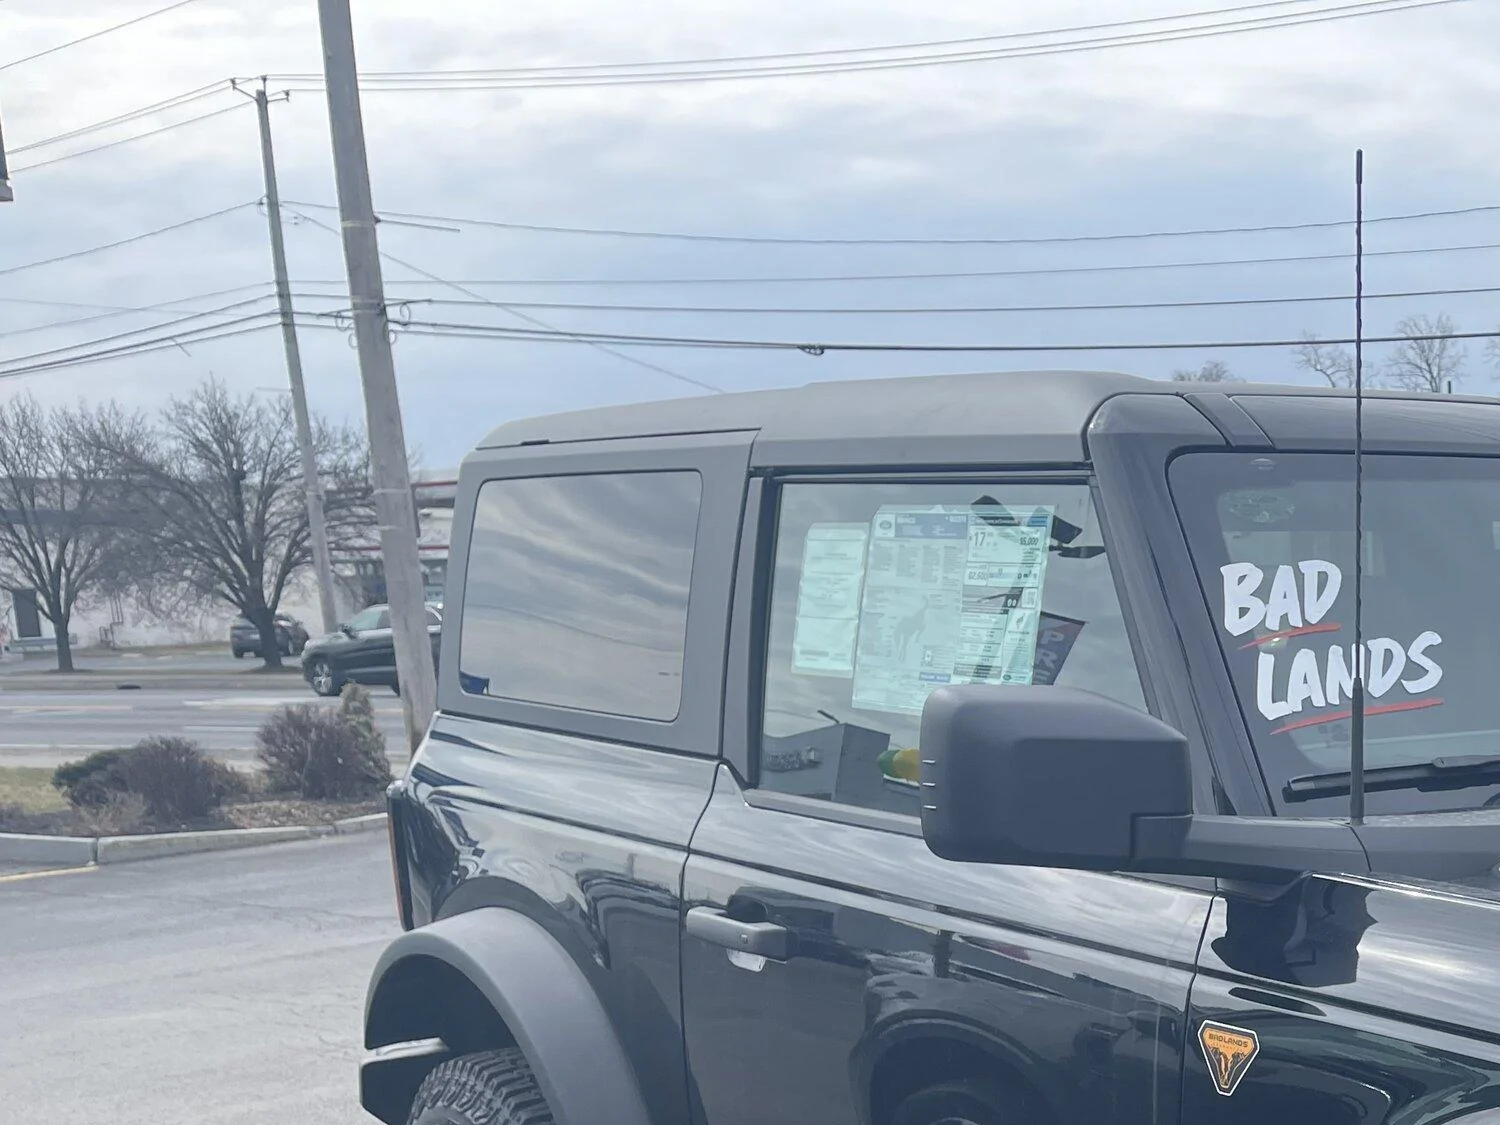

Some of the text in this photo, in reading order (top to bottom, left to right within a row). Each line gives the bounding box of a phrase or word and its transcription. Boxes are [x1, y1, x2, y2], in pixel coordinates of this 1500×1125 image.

[974, 531, 986, 546] 17
[1219, 560, 1342, 637] BAD
[1257, 631, 1443, 721] LANDS
[1208, 1033, 1249, 1049] BADLANDS
